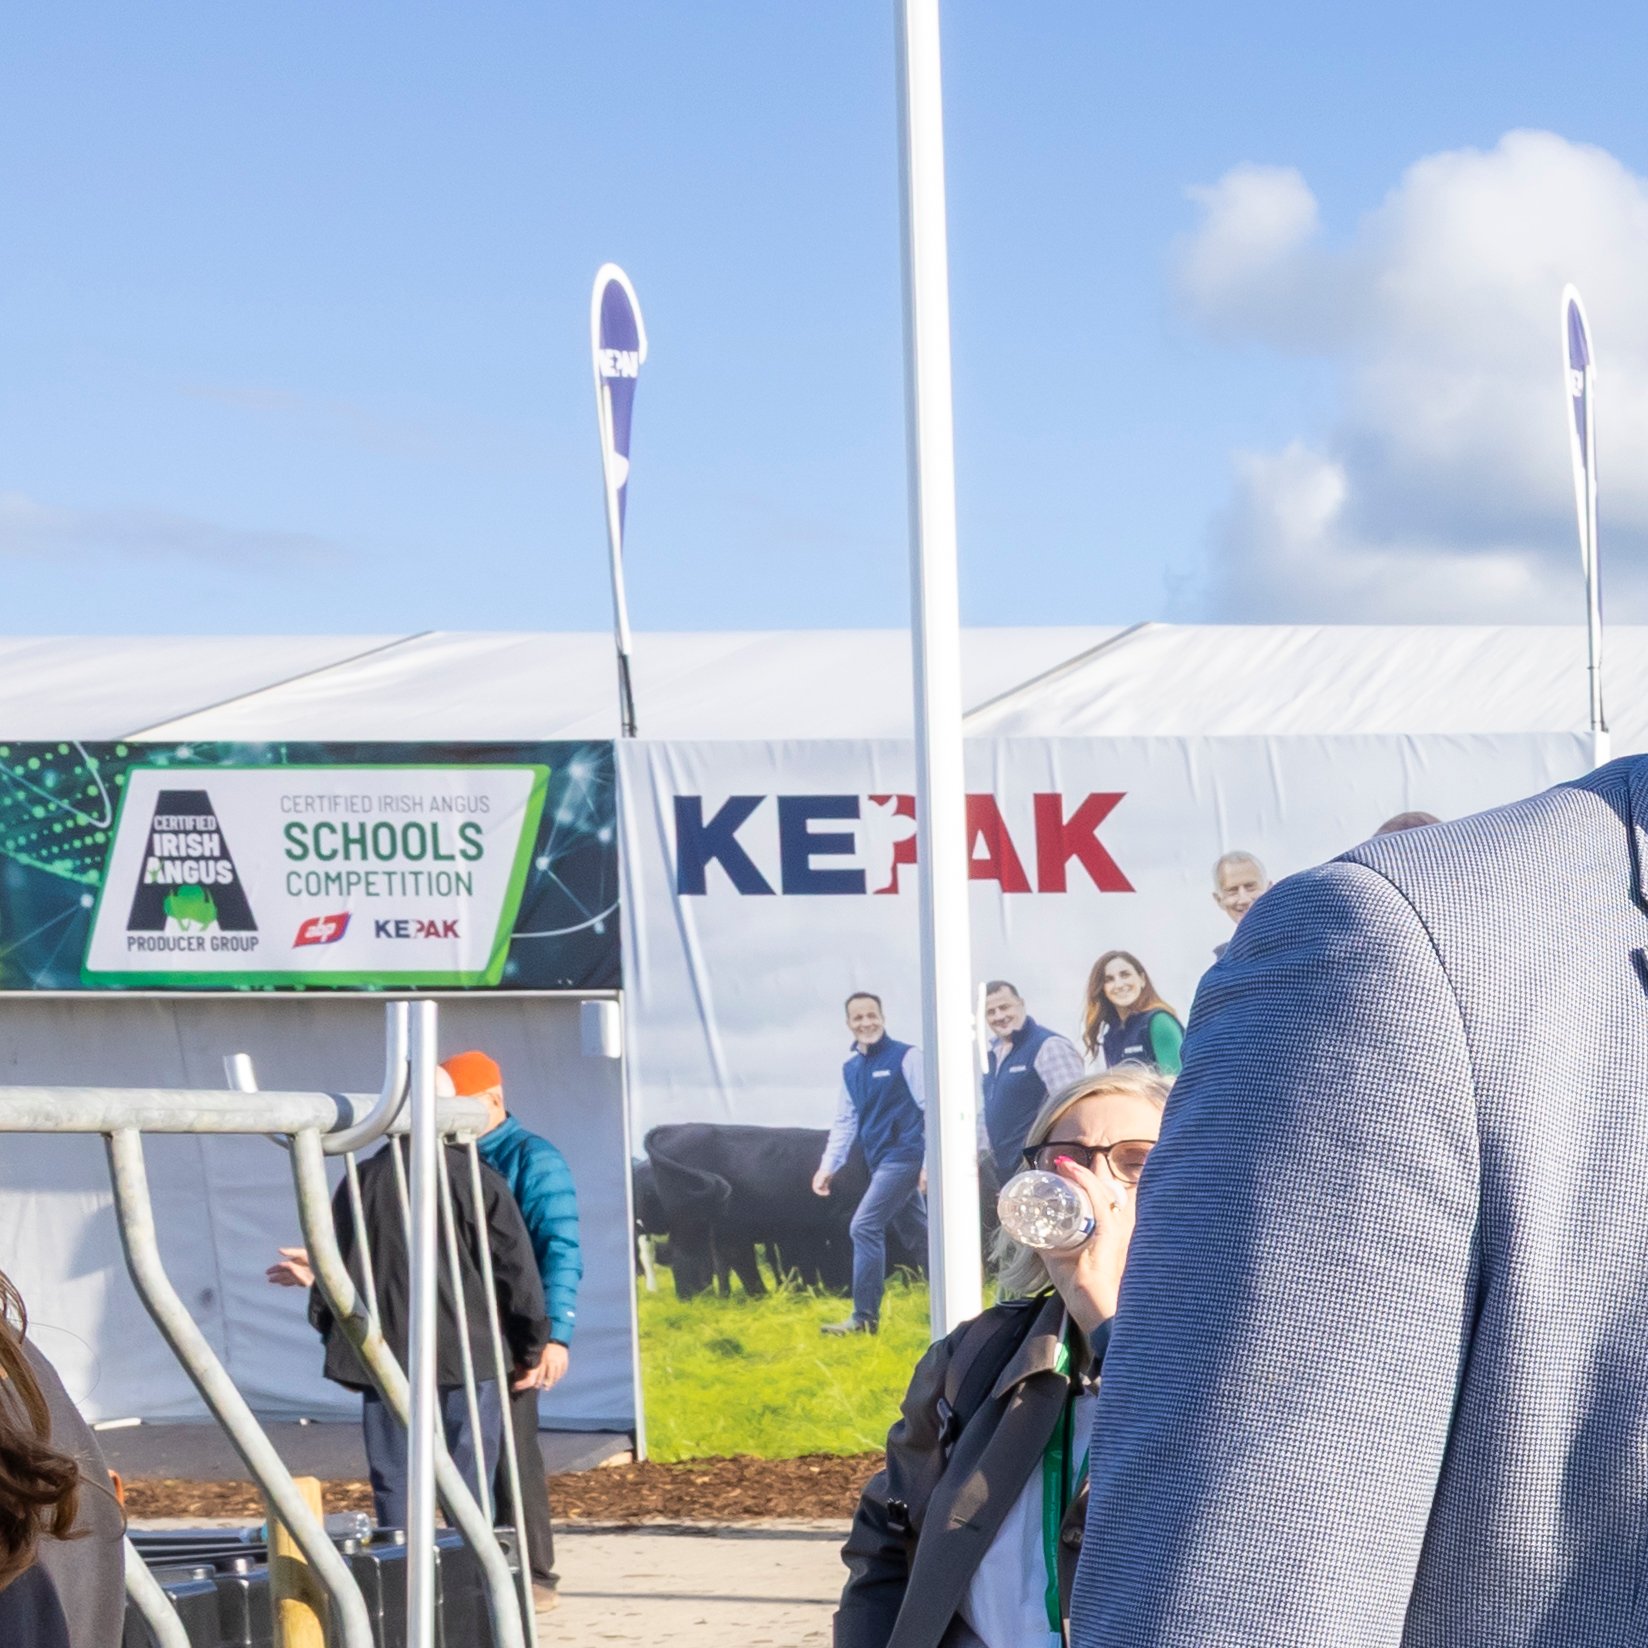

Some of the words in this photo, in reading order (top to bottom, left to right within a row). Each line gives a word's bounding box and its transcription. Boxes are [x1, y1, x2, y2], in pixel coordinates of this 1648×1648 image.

[279, 795, 373, 814] CERTIFIED
[377, 795, 424, 813] IRISH
[429, 795, 491, 814] ANGUS
[154, 815, 217, 831] CERTIFIED
[152, 833, 221, 857] IRISH
[283, 821, 484, 862] SCHOOLS
[143, 856, 234, 885] ANGUS
[286, 871, 474, 897] COMPETITION
[374, 919, 461, 939] KEPAK
[127, 936, 205, 952] PRODUCER
[210, 936, 259, 952] GROUP
